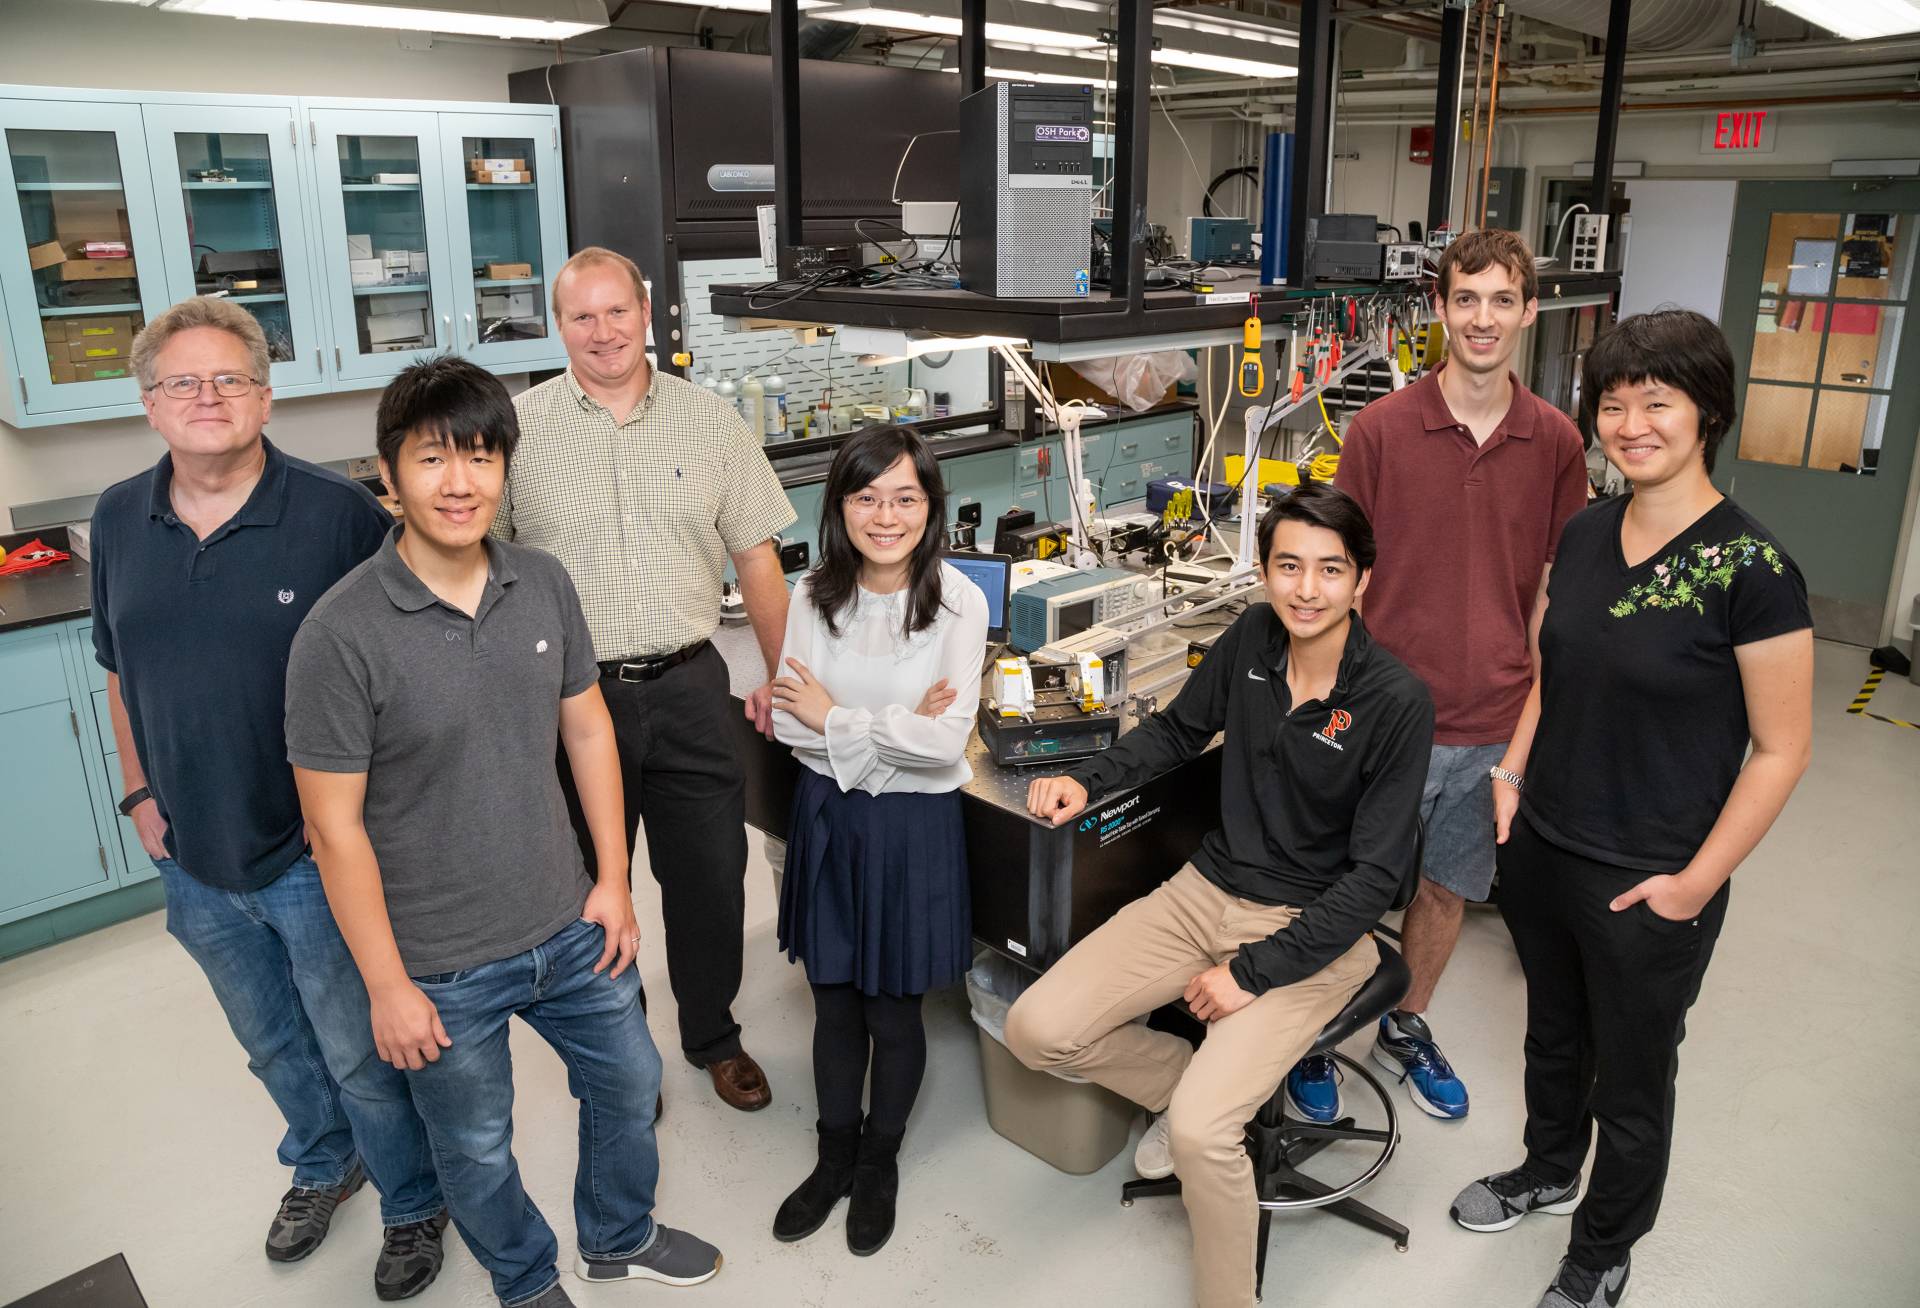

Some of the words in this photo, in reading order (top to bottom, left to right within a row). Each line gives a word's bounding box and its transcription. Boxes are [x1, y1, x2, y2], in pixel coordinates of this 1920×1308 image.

[1037, 127, 1056, 136] OSH
[1059, 128, 1076, 137] Park
[1714, 111, 1767, 149] EXIT
[1100, 795, 1140, 821] Newport
